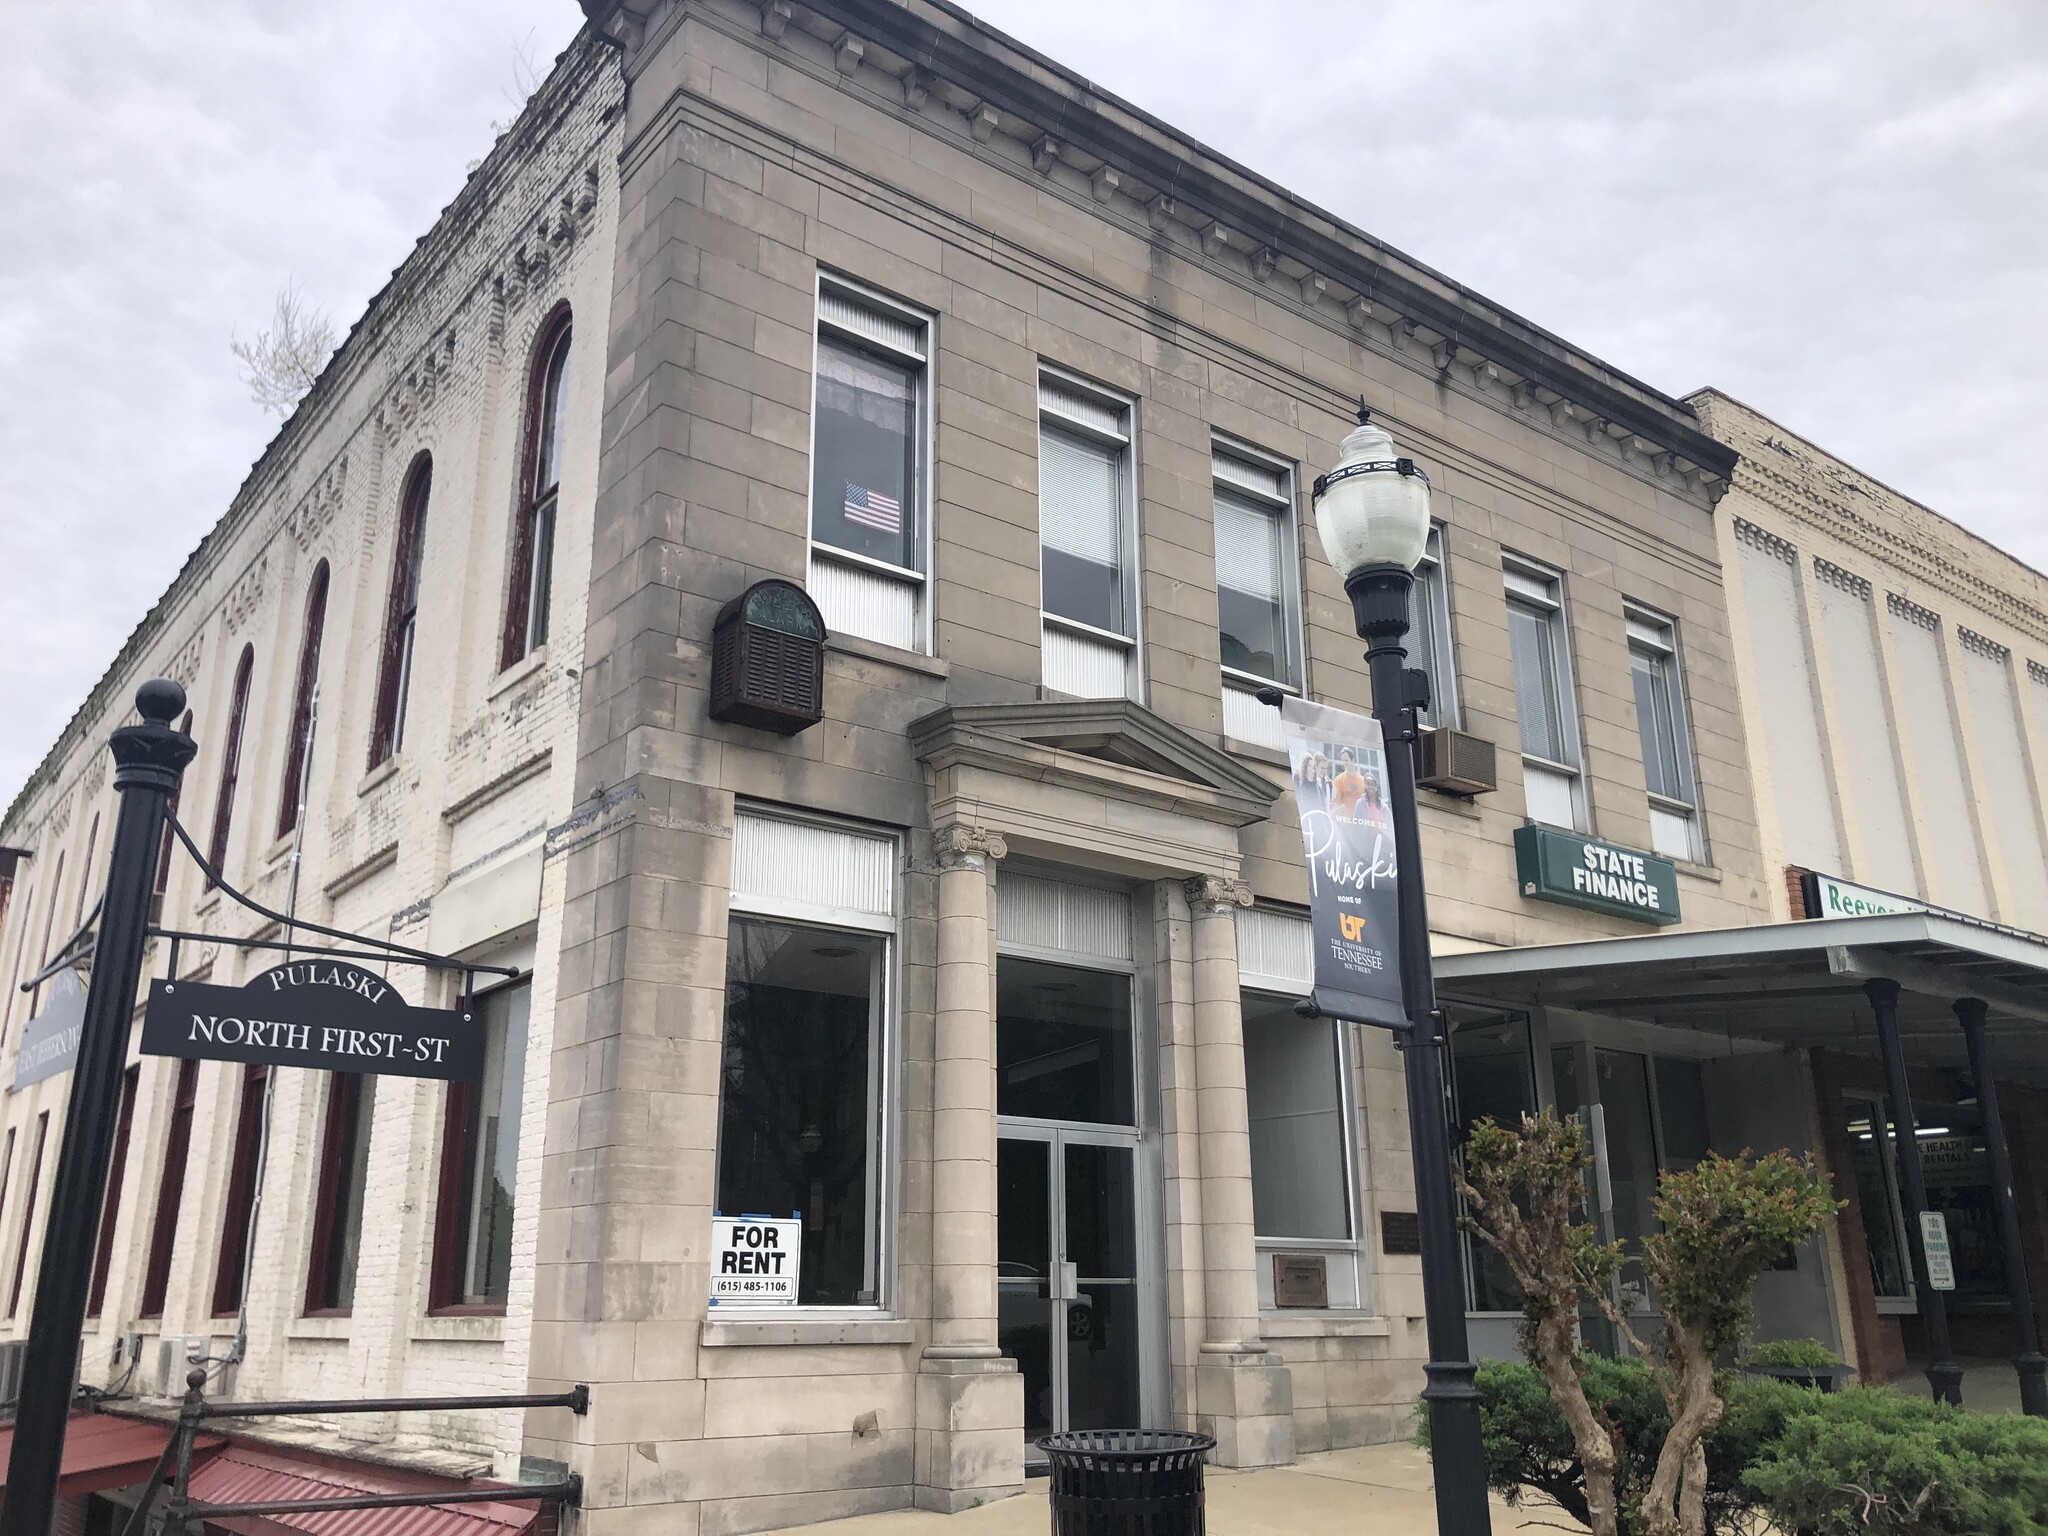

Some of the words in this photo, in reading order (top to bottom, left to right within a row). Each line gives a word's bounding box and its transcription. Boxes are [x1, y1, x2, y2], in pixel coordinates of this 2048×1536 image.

[1335, 814, 1376, 827] WELCOME
[1377, 821, 1388, 829] TO
[1302, 810, 1397, 898] Pulaski
[1337, 895, 1354, 903] HOME
[1573, 867, 1660, 909] FINANCE
[1828, 884, 1895, 915] Reeve
[1339, 912, 1366, 943] UT
[1330, 938, 1341, 946] THE
[1342, 941, 1374, 955] UNIVERSITY
[1331, 945, 1383, 970] TENNESSEE
[1344, 962, 1372, 974] SOUTHERN
[268, 965, 388, 1004] PULASKI
[188, 1014, 312, 1051] NORTH
[1926, 1141, 1962, 1153] HEALTH
[732, 1226, 779, 1248] FOR
[721, 1251, 786, 1274] RENT
[717, 1281, 741, 1292] (615)
[744, 1281, 787, 1292] 485-1106
